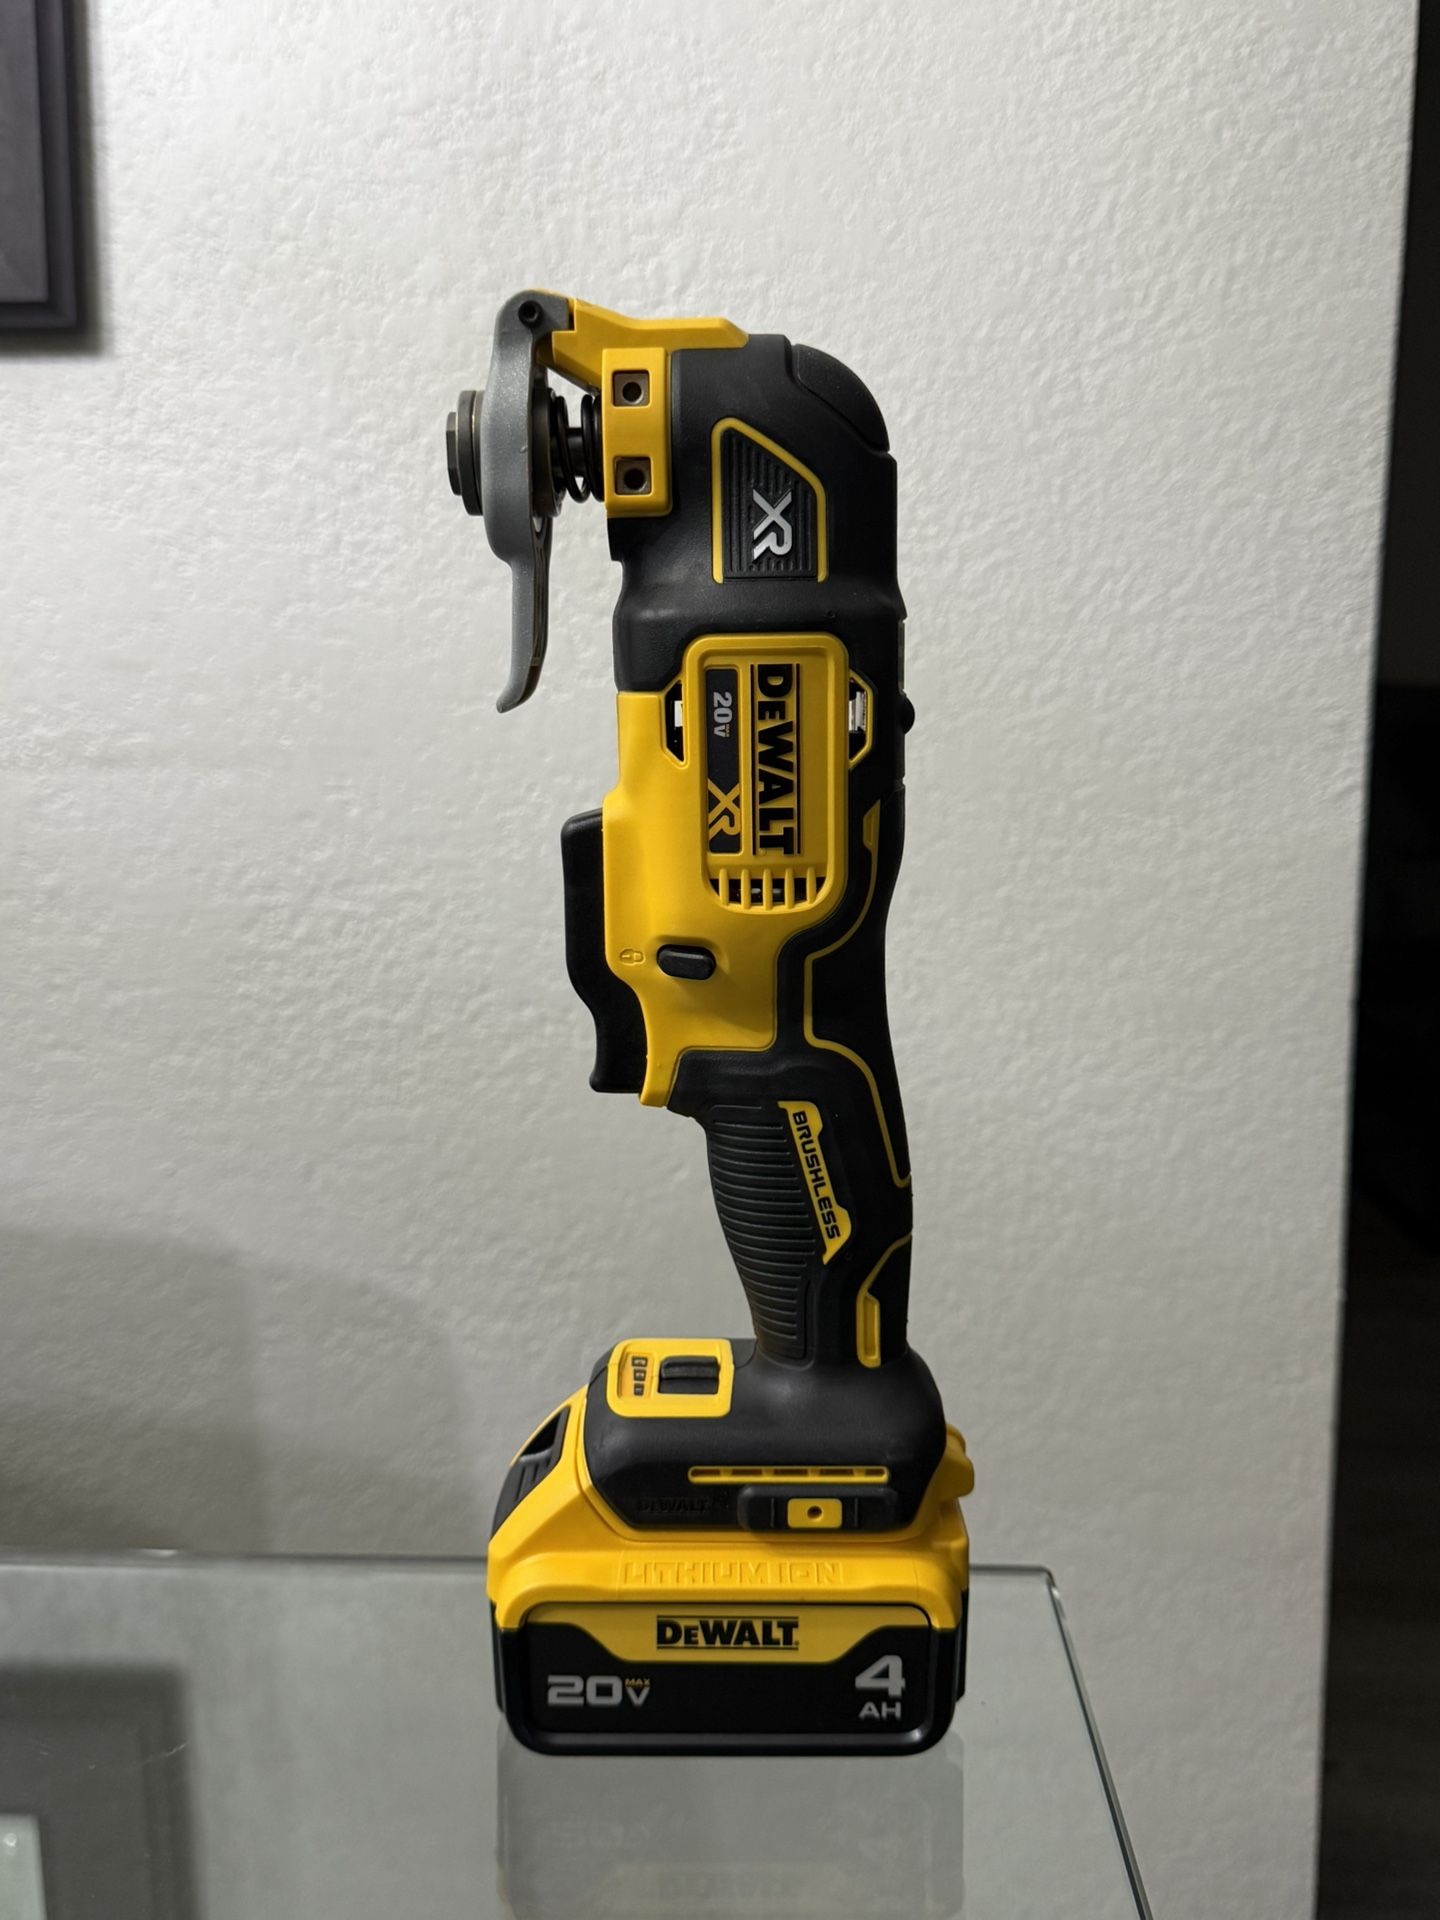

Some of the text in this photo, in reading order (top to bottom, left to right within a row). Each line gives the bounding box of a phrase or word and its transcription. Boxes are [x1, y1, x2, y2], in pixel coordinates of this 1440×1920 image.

[753, 488, 792, 560] XR
[708, 777, 740, 840] XR
[793, 1111, 841, 1239] BRUSHLESS
[624, 1562, 843, 1585] LITHIUM ION
[625, 1678, 650, 1687] MAX
[855, 1654, 905, 1697] 4
[858, 1702, 902, 1719] AH
